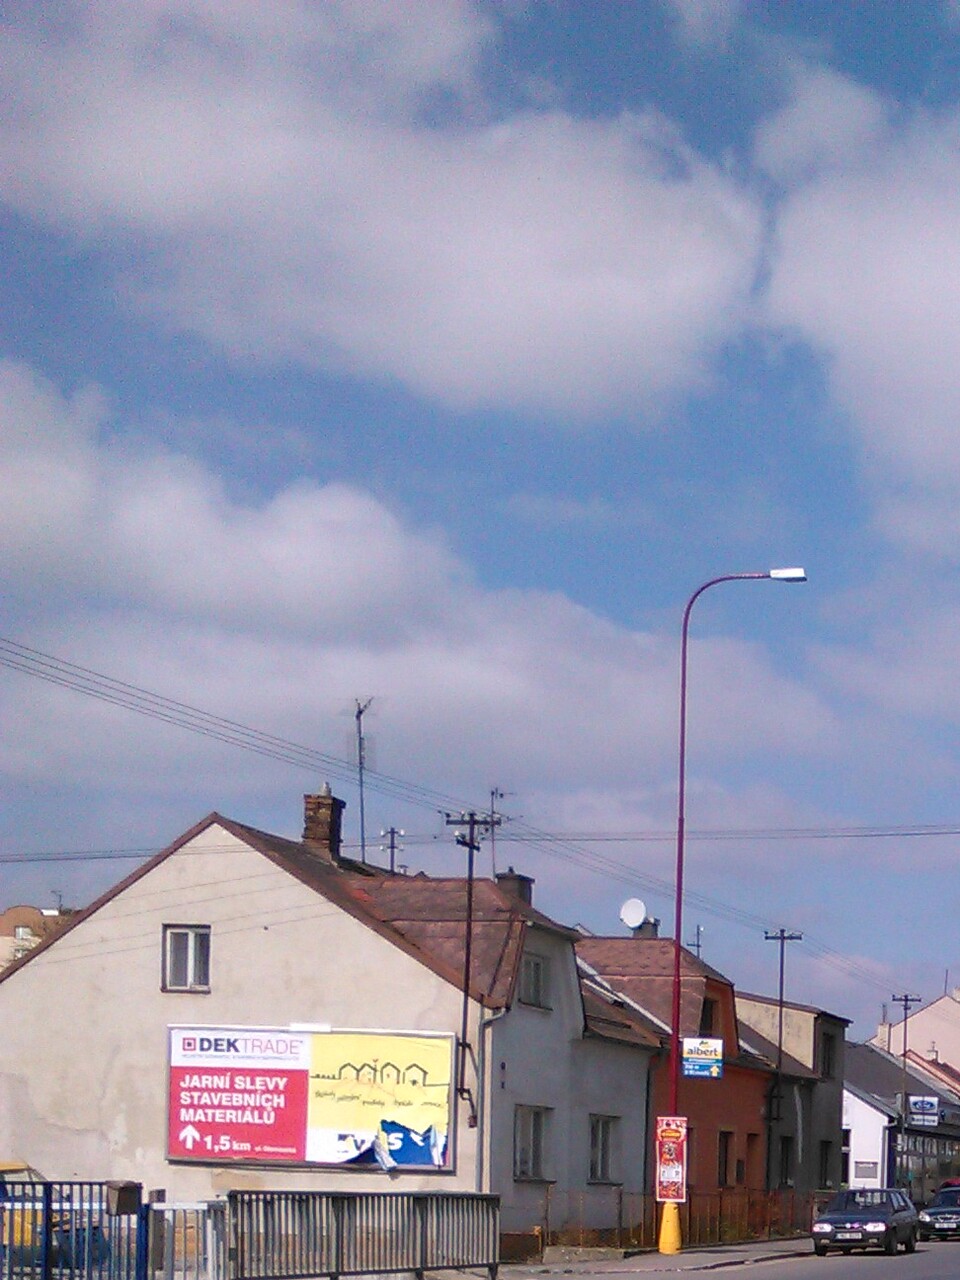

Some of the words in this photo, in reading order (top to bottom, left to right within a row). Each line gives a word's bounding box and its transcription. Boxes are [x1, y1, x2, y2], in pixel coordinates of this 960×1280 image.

[199, 1037, 301, 1055] DEKTRADE
[687, 1046, 718, 1057] albert
[179, 1072, 230, 1090] JARNÍ
[234, 1076, 288, 1091] SLEVY
[179, 1090, 286, 1108] STAVEBNÍCH
[179, 1106, 276, 1125] MATERIÁLŮ
[203, 1134, 231, 1154] 1,5
[232, 1141, 252, 1152] km
